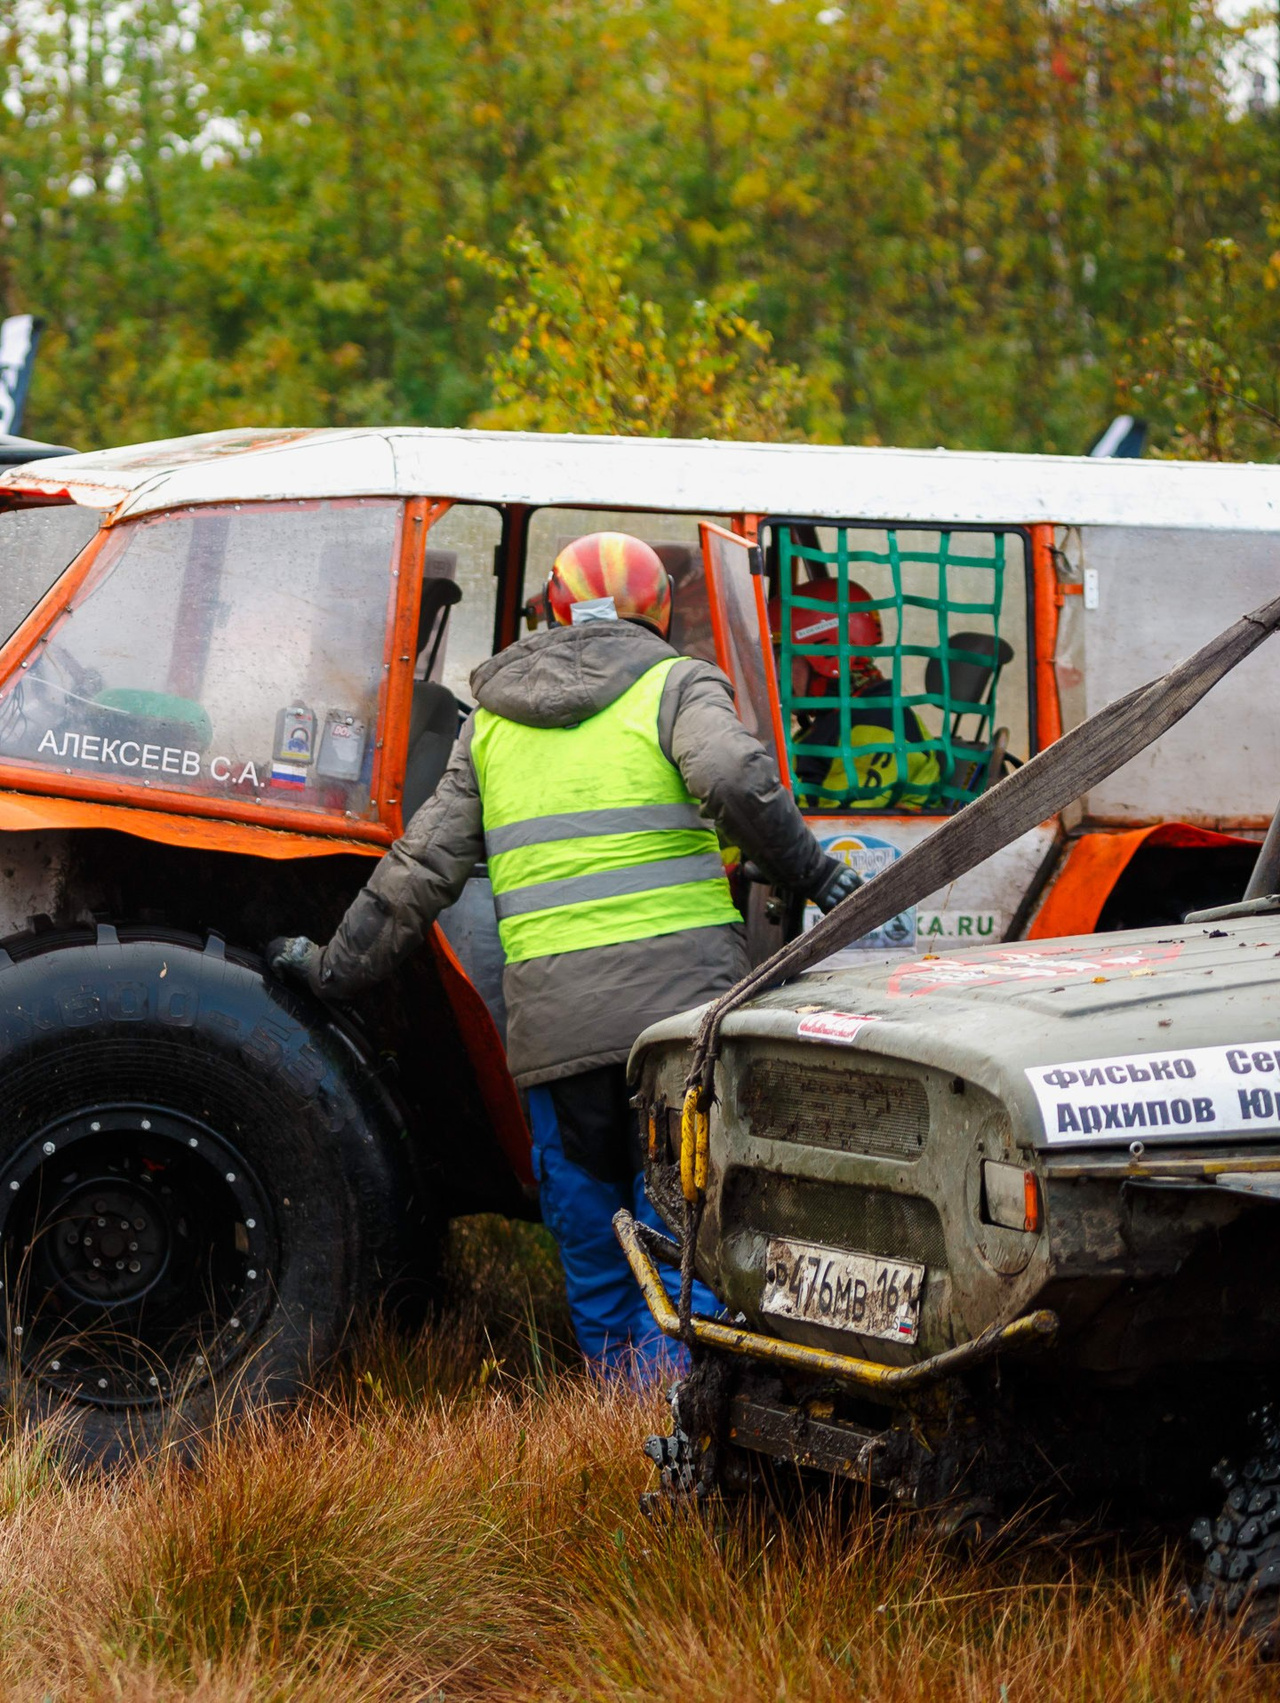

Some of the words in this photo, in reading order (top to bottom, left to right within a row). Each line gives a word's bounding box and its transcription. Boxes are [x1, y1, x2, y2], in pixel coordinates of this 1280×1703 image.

[37, 729, 201, 776] АЛЕКСЕЕВ
[210, 756, 265, 788] С.А.
[1042, 1058, 1197, 1089] Фисько
[1056, 1096, 1216, 1134] Архипов
